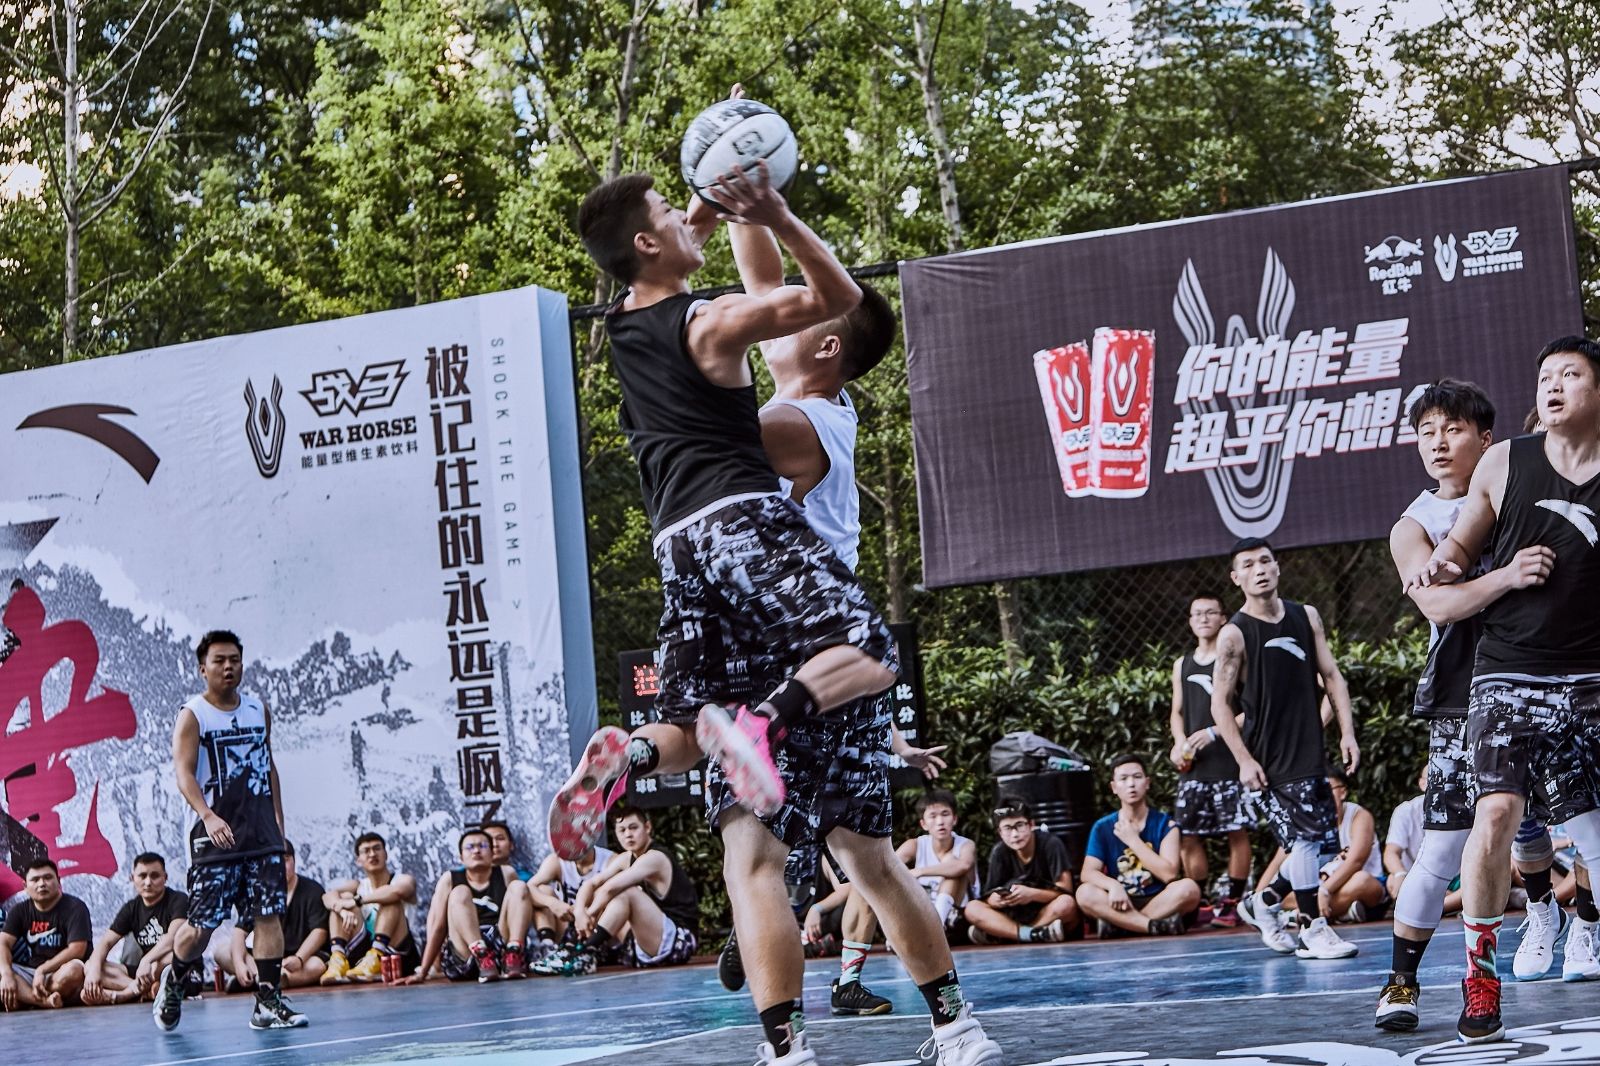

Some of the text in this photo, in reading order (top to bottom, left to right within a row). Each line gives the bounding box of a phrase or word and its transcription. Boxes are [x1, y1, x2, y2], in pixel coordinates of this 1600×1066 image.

[1381, 276, 1412, 295] 红牛
[1173, 317, 1410, 406] 你的能量
[299, 416, 417, 450] WAR HORSE
[301, 439, 418, 469] 能量型维生素饮料
[491, 337, 521, 568] SHOCK THE GAME
[1164, 383, 1433, 475] 超乎你想
